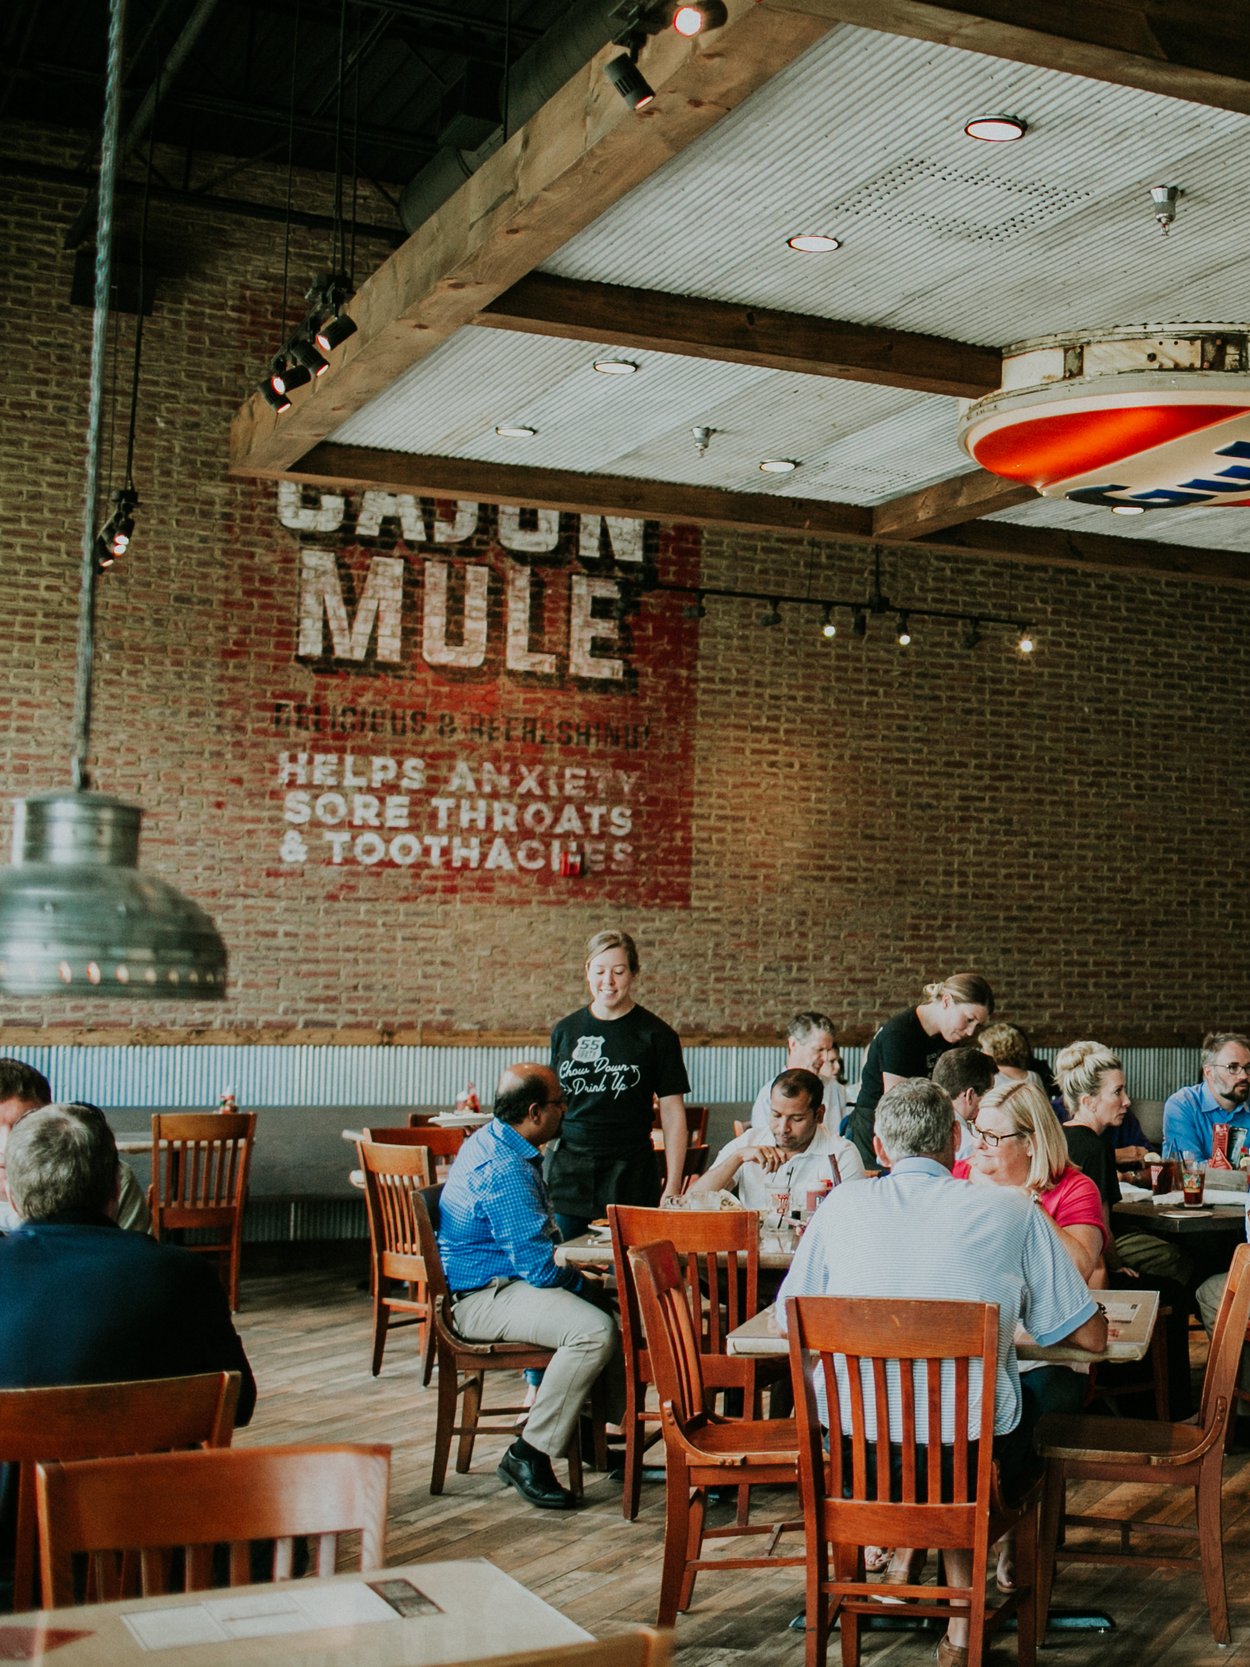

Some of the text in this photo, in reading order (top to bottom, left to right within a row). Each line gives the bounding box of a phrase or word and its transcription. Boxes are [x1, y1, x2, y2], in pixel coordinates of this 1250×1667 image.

[298, 550, 624, 680] MULE
[277, 752, 426, 788] HELPS
[284, 791, 633, 836] SORE THROATS
[279, 830, 308, 864] &
[580, 1040, 601, 1050] 55
[560, 1057, 630, 1079] Chow Down
[573, 1072, 628, 1100] Drink Up
